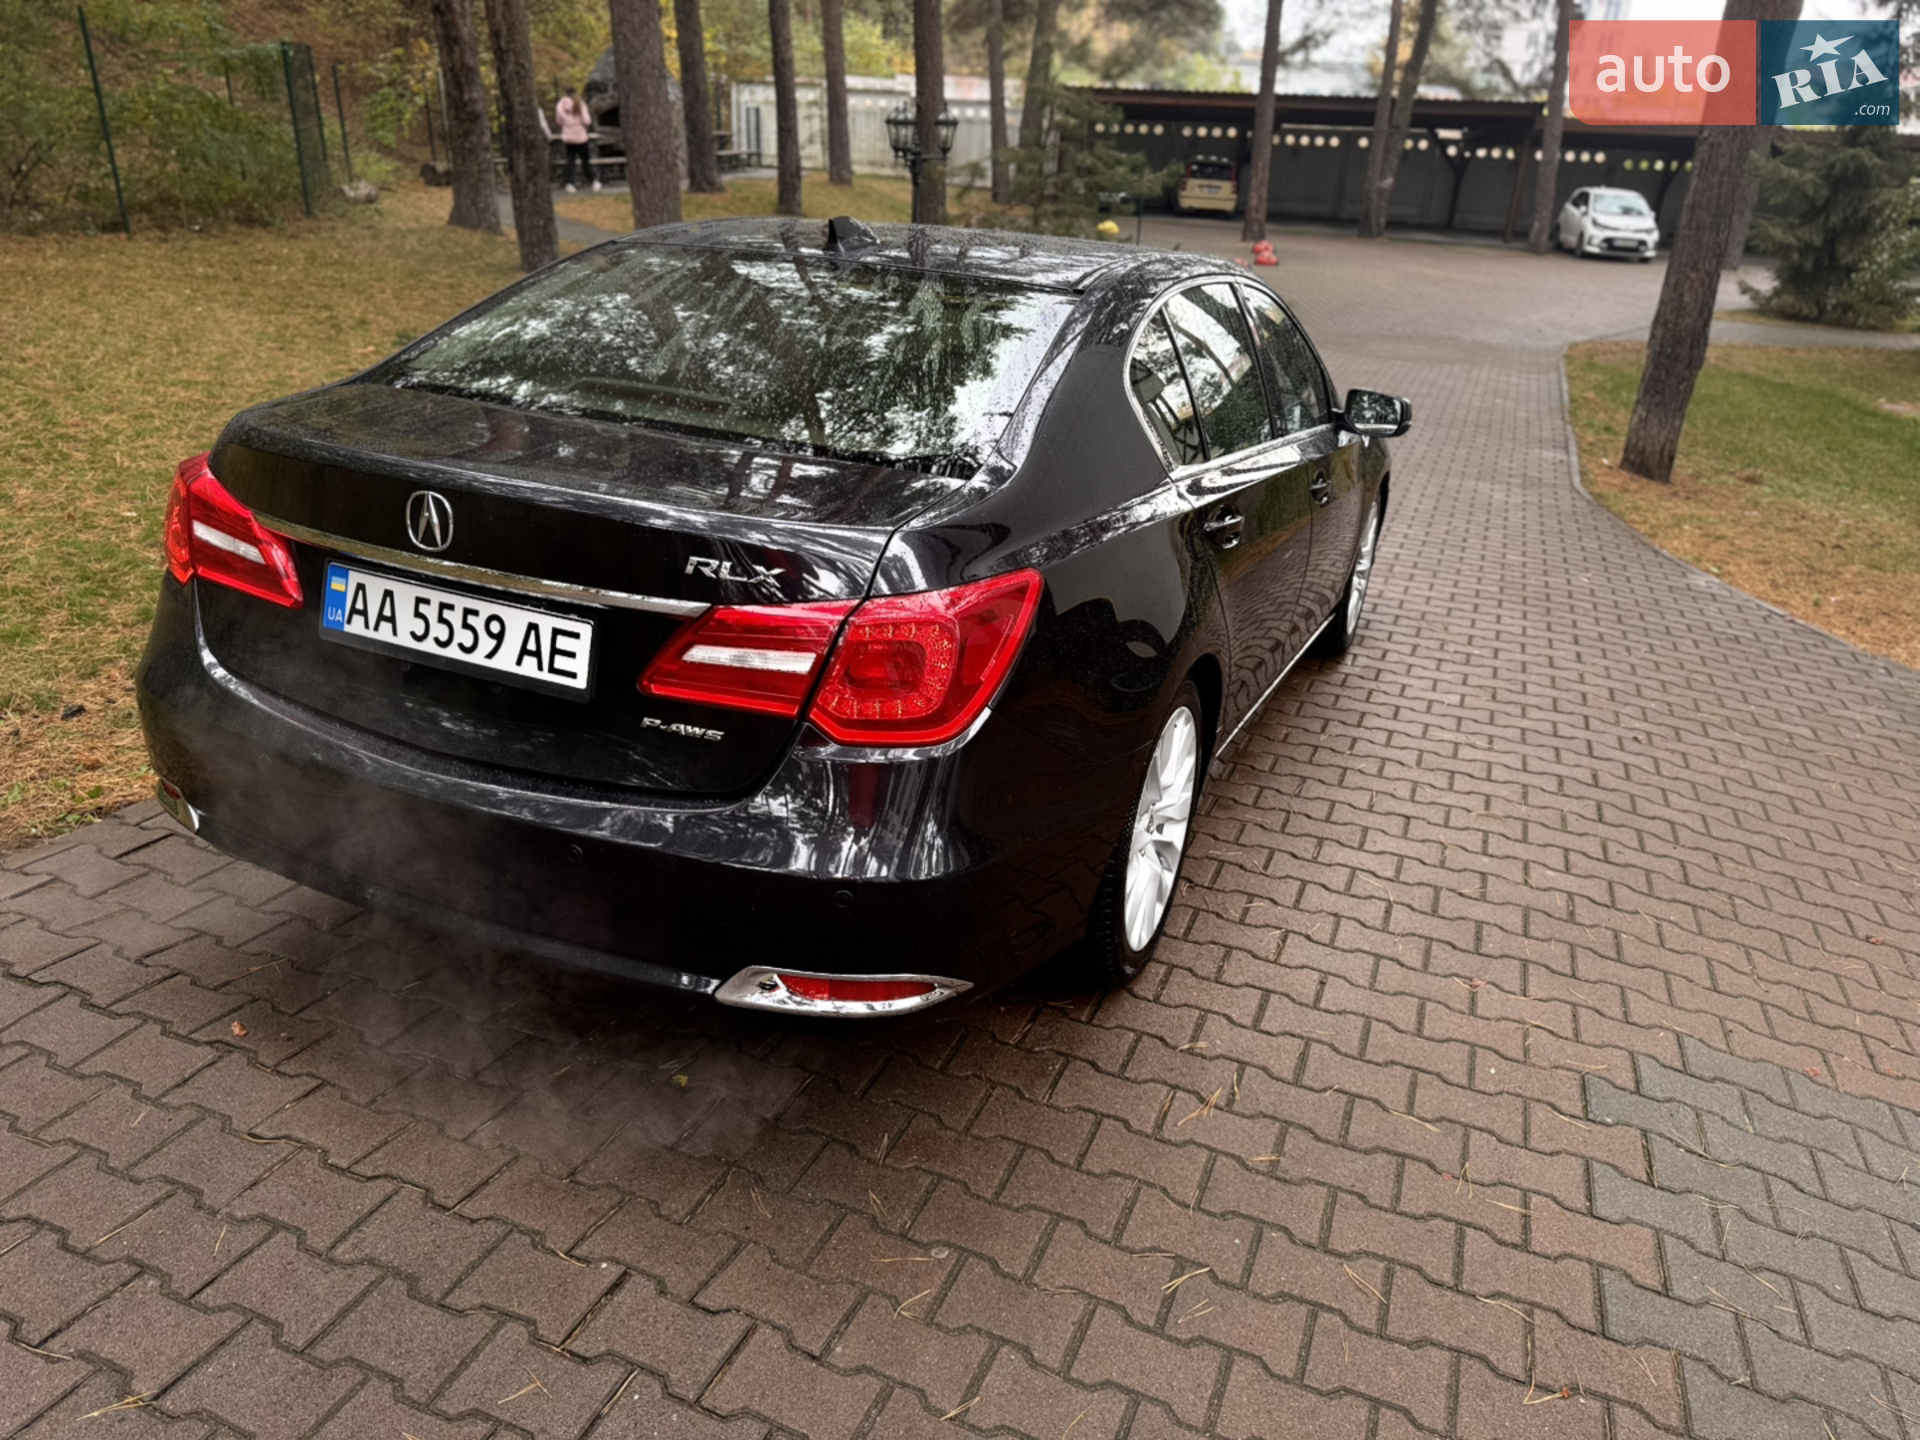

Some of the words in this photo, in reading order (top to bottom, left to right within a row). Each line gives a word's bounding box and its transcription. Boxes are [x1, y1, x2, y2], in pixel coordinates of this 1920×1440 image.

[684, 556, 786, 588] RLX
[327, 606, 343, 623] UA
[346, 582, 398, 637] AA
[409, 595, 506, 660] 5559
[515, 621, 581, 680] AE
[640, 716, 725, 741] P-AWS
